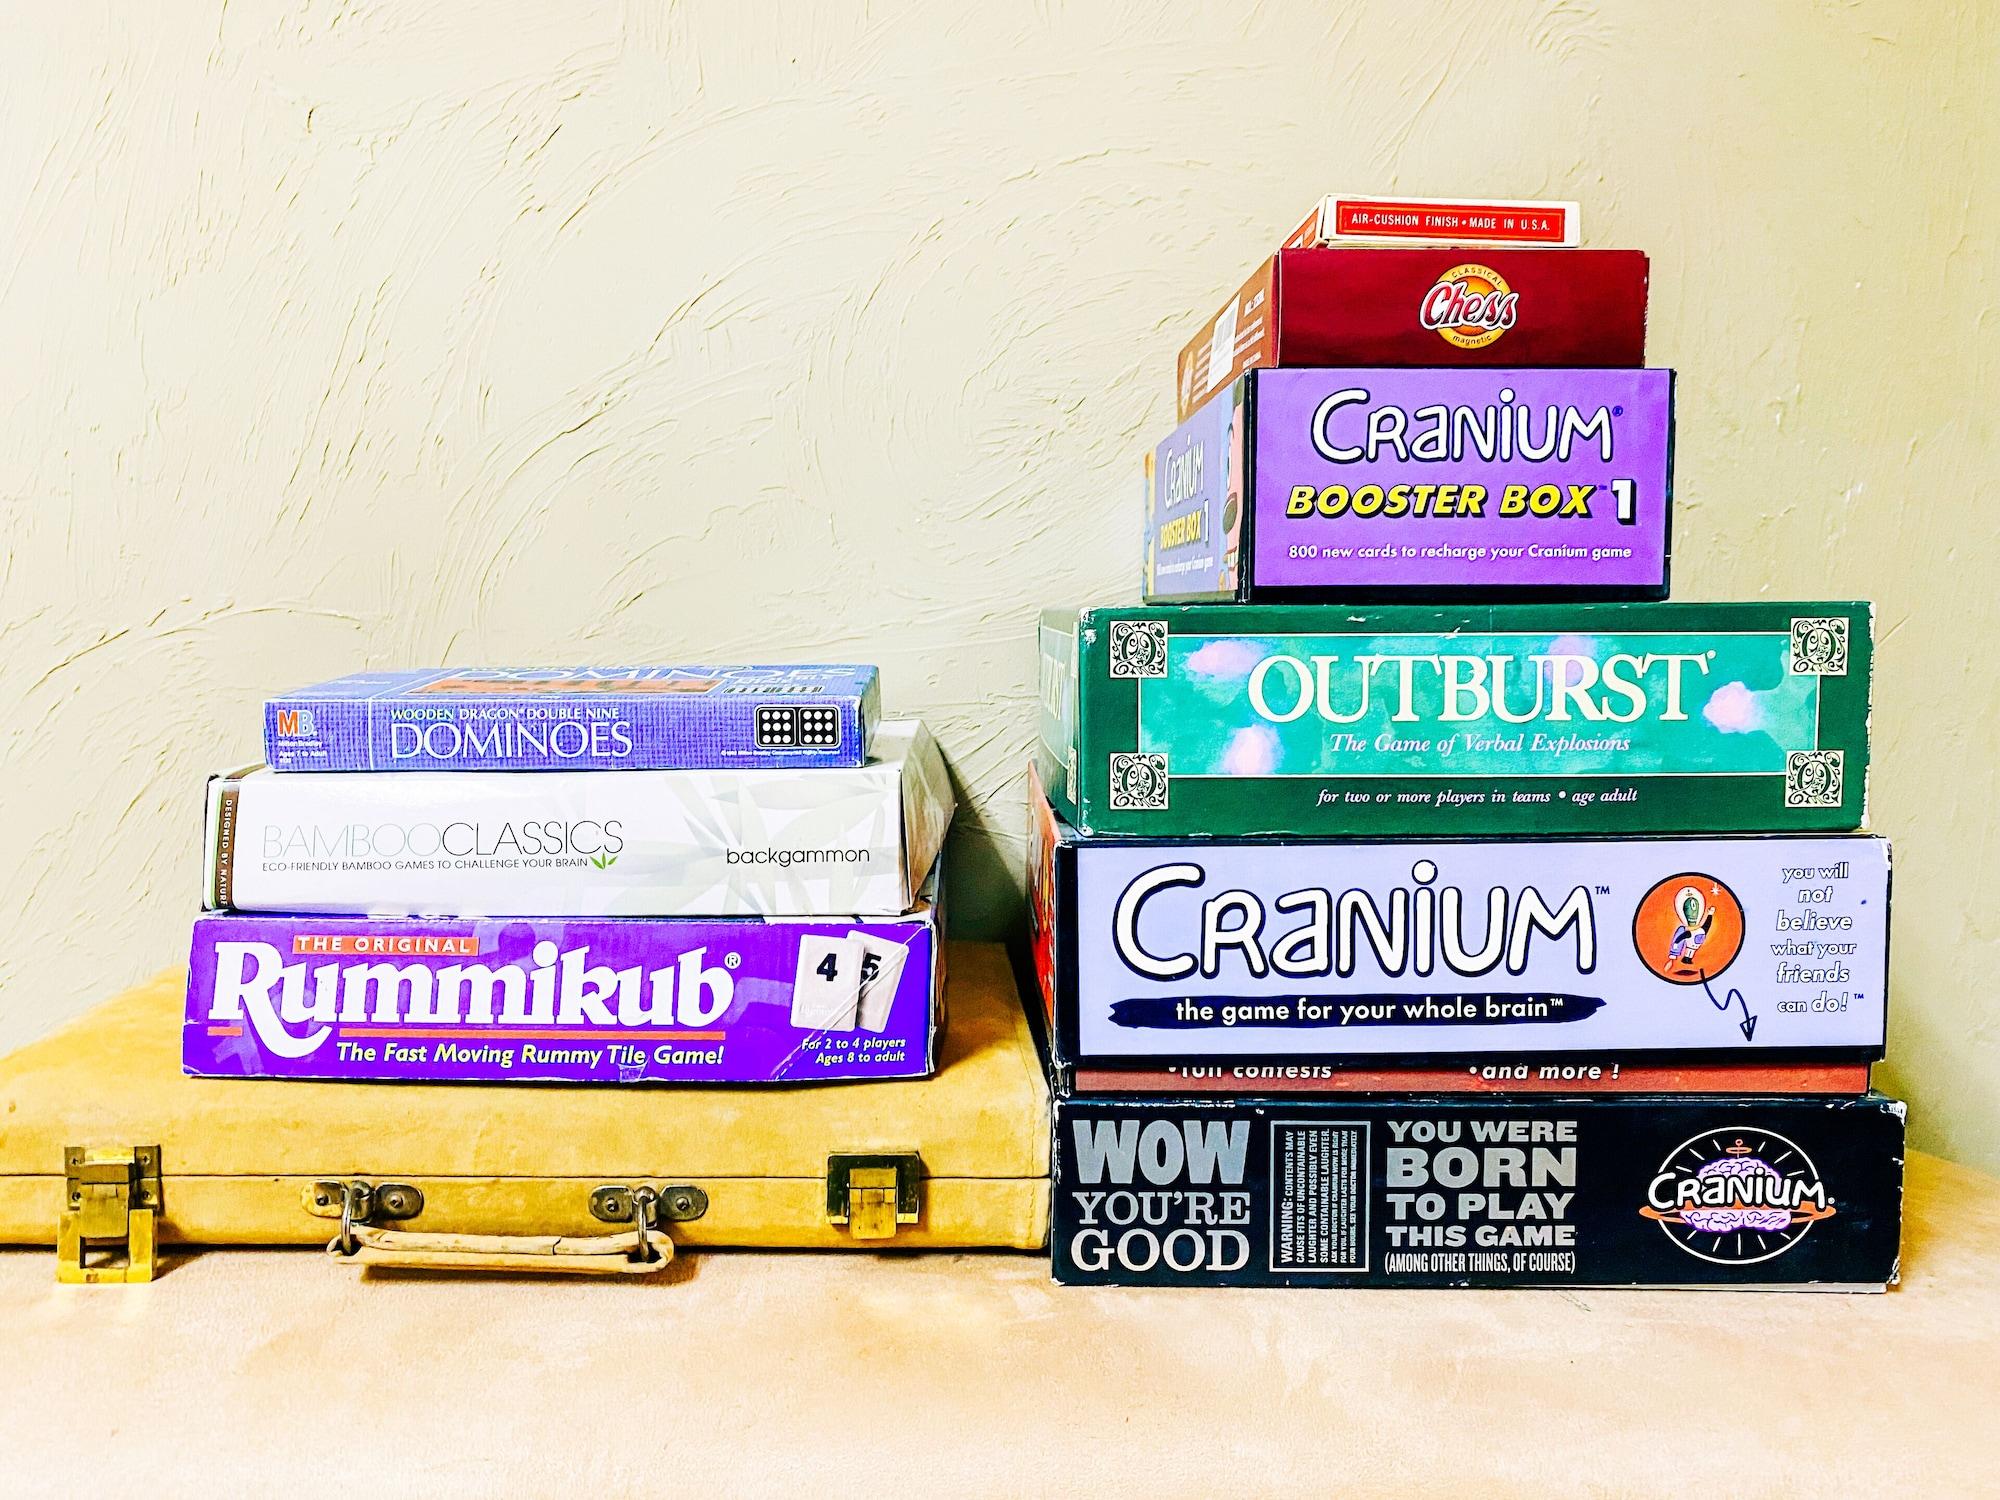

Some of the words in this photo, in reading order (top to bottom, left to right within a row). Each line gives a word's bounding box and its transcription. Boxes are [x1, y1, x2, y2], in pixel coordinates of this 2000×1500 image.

[1352, 212, 1419, 226] AIR-CUSHION
[1425, 214, 1459, 227] FINISH
[1469, 217, 1496, 229] MADE
[1503, 218, 1514, 229] IN
[1521, 219, 1550, 231] U.S.A.
[1452, 267, 1502, 286] CLASSICAL
[1420, 281, 1520, 331] Chess
[1453, 335, 1492, 347] magnetic
[1286, 484, 1488, 518] BOOSTER
[1499, 484, 1597, 518] BOX
[1611, 478, 1637, 525] 1
[1160, 516, 1185, 550] BOOSTER
[1186, 510, 1201, 545] BOX
[1289, 545, 1318, 558] 800
[1322, 548, 1353, 558] new
[1357, 544, 1397, 558] cards
[1401, 546, 1416, 558] to
[1420, 543, 1487, 560] recharge
[1490, 547, 1524, 561] your
[1528, 543, 1588, 558] Cranium
[1591, 547, 1632, 560] game
[1248, 653, 1710, 723] OUTBURST
[390, 709, 454, 720] WOODEN
[526, 709, 581, 720] DOUBLE
[585, 708, 619, 719] NINE
[391, 721, 633, 759] DOMINOES
[1330, 733, 1366, 752] The
[1374, 733, 1430, 752] Game
[1436, 733, 1460, 758] of
[1464, 733, 1523, 752] Verbal
[1531, 733, 1631, 757] Explosions
[1315, 788, 1339, 807] for
[1344, 791, 1370, 803] two
[1375, 792, 1392, 803] or
[1397, 792, 1431, 803] more
[1434, 789, 1485, 807] players
[1491, 789, 1506, 802] in
[1512, 790, 1551, 803] teams
[1571, 791, 1595, 806] age
[1600, 788, 1638, 802] adult
[222, 799, 233, 848] DESIGNED
[221, 853, 228, 865] BY
[262, 861, 338, 872] ECO-FRIENDLY
[342, 861, 391, 871] BAMBOO
[395, 860, 434, 870] GAMES
[437, 860, 451, 869] TO
[454, 859, 519, 869] CHALLENGE
[523, 858, 552, 868] YOUR
[555, 858, 588, 868] BRAIN
[727, 848, 870, 867] backgammon
[1782, 868, 1815, 883] you
[1818, 862, 1849, 879] will
[1798, 886, 1833, 903] not
[1776, 909, 1852, 931] believe
[297, 936, 342, 952] THE
[354, 937, 471, 954] ORIGINAL
[1771, 938, 1814, 955] what
[1817, 943, 1857, 959] your
[816, 953, 838, 982] 4
[860, 952, 882, 985] 5
[1776, 961, 1849, 983] friends
[1176, 998, 1213, 1020] the
[1221, 1005, 1290, 1026] game
[1298, 997, 1332, 1020] for
[1339, 1003, 1396, 1025] your
[1403, 995, 1477, 1018] whole
[1777, 1000, 1807, 1013] can
[336, 1042, 376, 1063] The
[384, 1043, 427, 1062] Fast
[432, 1043, 514, 1067] Moving
[521, 1044, 603, 1069] Rummy
[606, 1044, 646, 1065] Tile
[654, 1045, 724, 1065] Game!
[802, 1038, 821, 1050] For
[824, 1038, 832, 1049] 2
[836, 1038, 849, 1049] to
[852, 1038, 860, 1049] 4
[863, 1037, 906, 1051] players
[815, 1053, 843, 1066] Ages
[847, 1052, 855, 1063] 8
[858, 1052, 871, 1063] to
[874, 1051, 905, 1062] adult
[1539, 1066, 1601, 1079] more
[1285, 1130, 1293, 1150] MAY
[1308, 1130, 1317, 1152] EVEN
[1387, 1120, 1461, 1142] YOU
[1470, 1120, 1578, 1142] WERE
[1072, 1119, 1250, 1186] WOW
[1320, 1129, 1329, 1175] LAUGHTER.
[1285, 1152, 1293, 1196] CONTENTS
[1296, 1130, 1305, 1201] UNCONTAINABLE
[1308, 1155, 1317, 1195] POSSIBLY
[1386, 1146, 1577, 1188] BORN
[1071, 1190, 1250, 1225] YOU'RE
[1296, 1202, 1305, 1213] OF
[1308, 1198, 1317, 1216] AND
[1320, 1176, 1329, 1236] CONTAINABLE
[1386, 1193, 1446, 1220] TO
[1458, 1193, 1575, 1220] PLAY
[1281, 1197, 1293, 1263] WARNING:
[1296, 1215, 1305, 1233] FITS
[1308, 1219, 1317, 1263] LAUGHTER
[1385, 1225, 1467, 1247] THIS
[1474, 1225, 1576, 1247] GAME
[1071, 1228, 1250, 1272] GOOD
[1296, 1234, 1305, 1263] CAUSE
[1320, 1238, 1329, 1263] SOME
[1384, 1251, 1429, 1275] (AMONG
[1431, 1253, 1466, 1272] OTHER
[1468, 1252, 1511, 1274] THINGS,
[1512, 1252, 1527, 1272] OF
[1528, 1251, 1576, 1274] COURSE)
